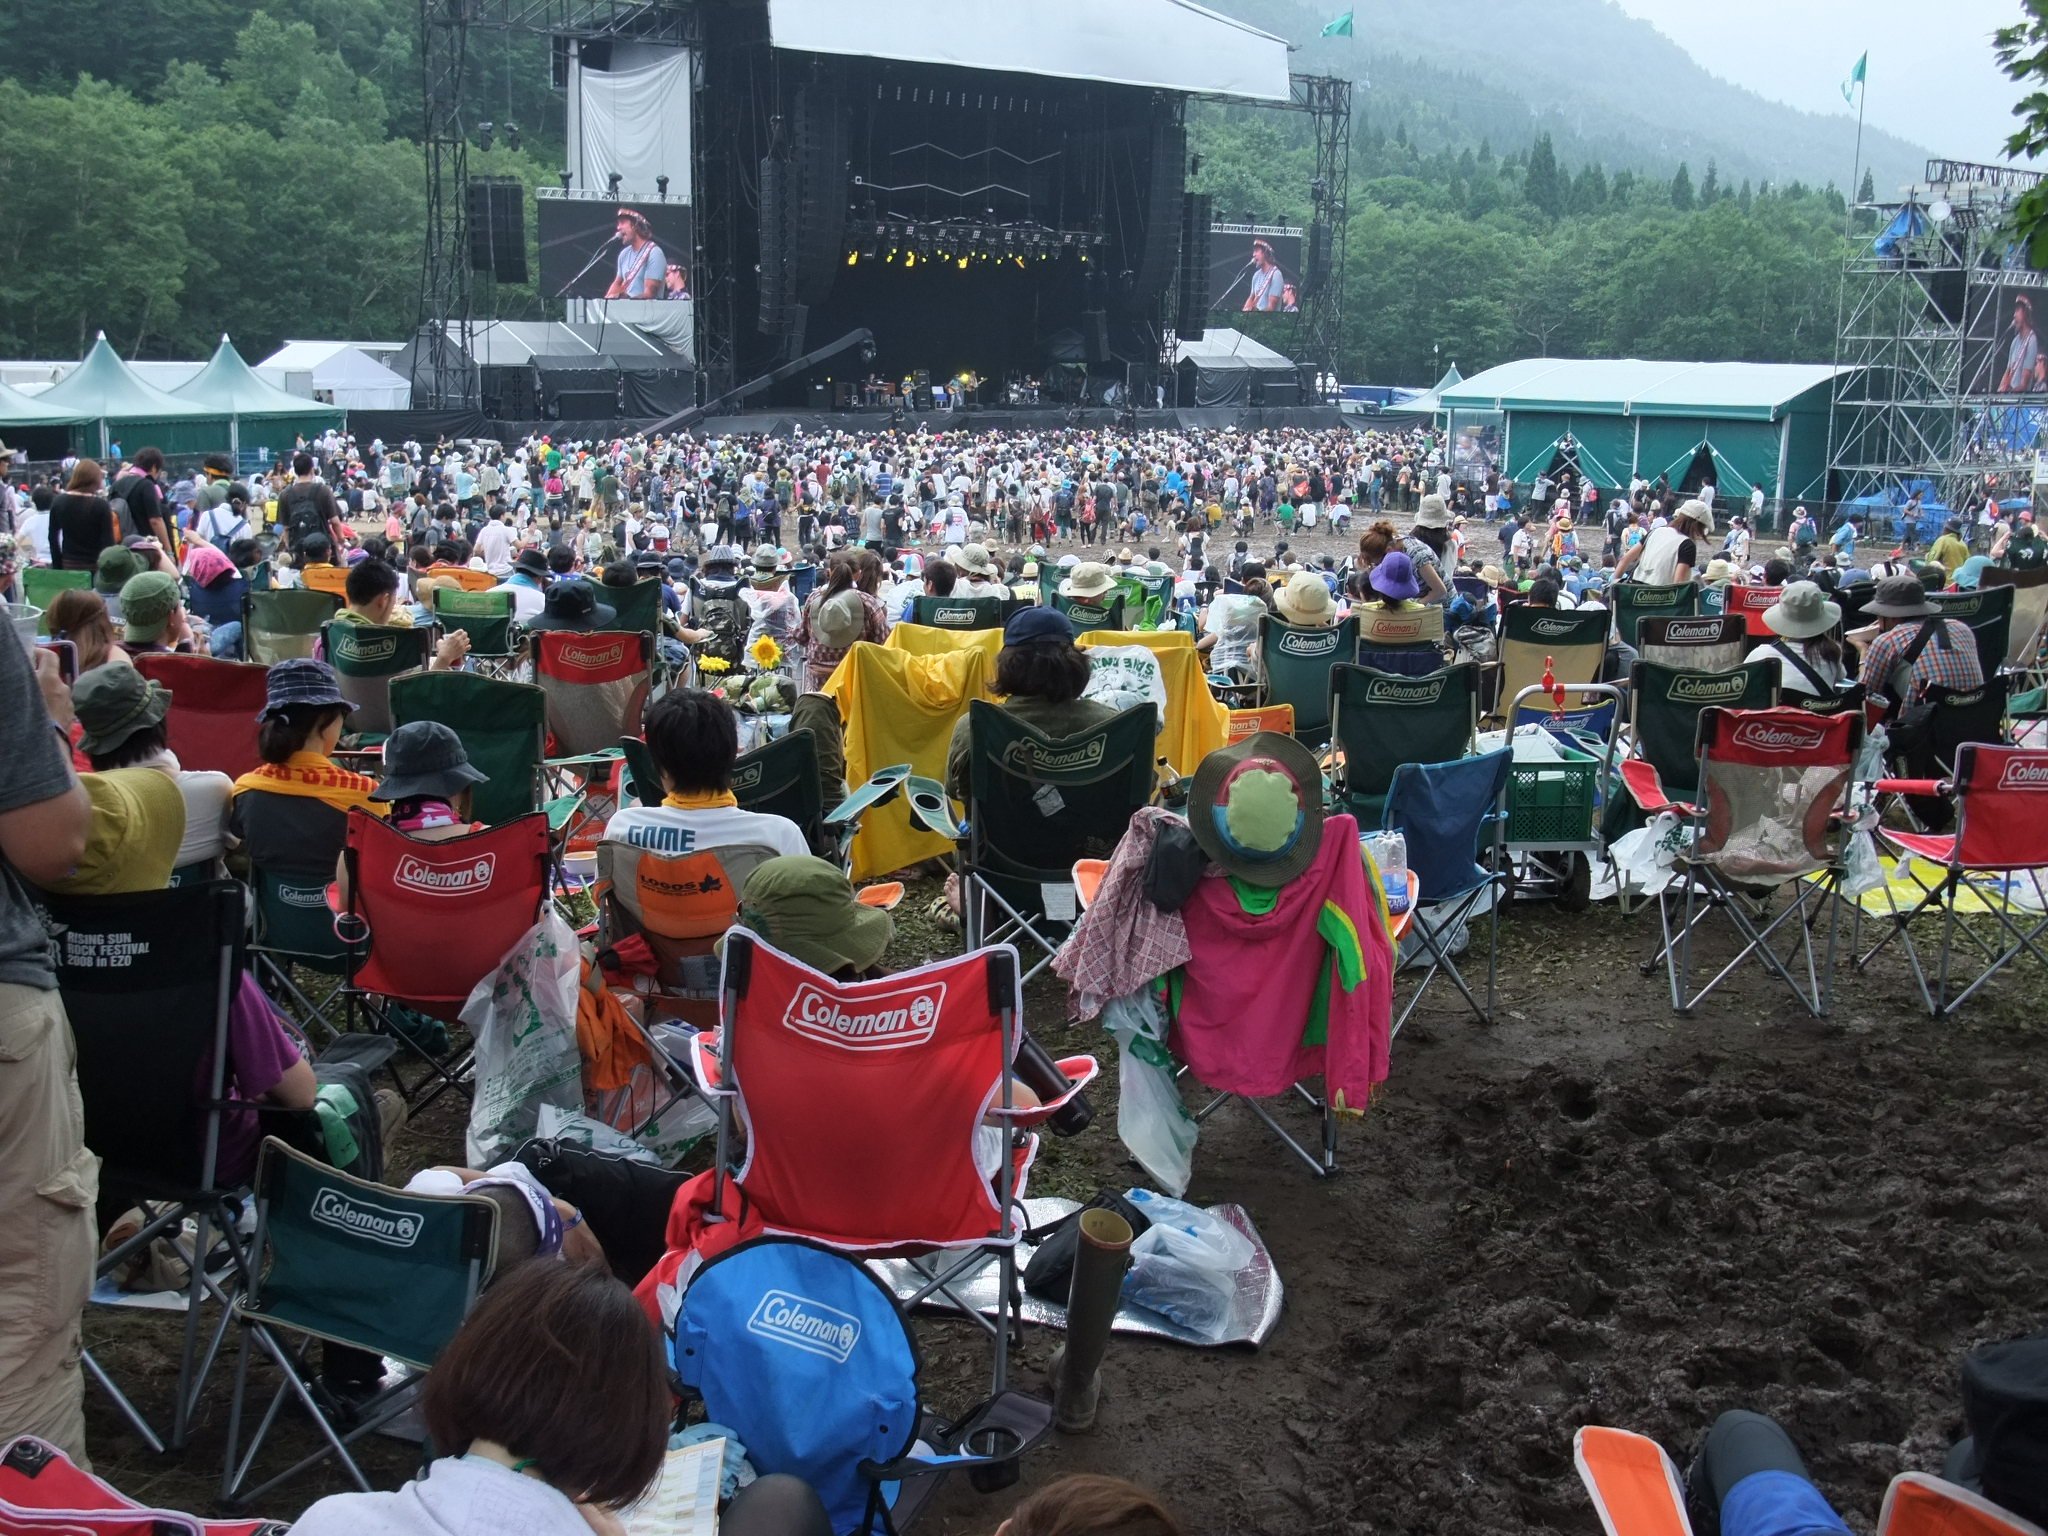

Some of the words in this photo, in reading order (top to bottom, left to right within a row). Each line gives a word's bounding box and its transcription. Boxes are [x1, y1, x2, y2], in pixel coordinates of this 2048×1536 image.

[1636, 591, 1669, 602] Coleman
[1748, 593, 1778, 604] Coleman
[938, 610, 967, 620] Coleman
[1072, 606, 1102, 620] Coleman
[1376, 622, 1411, 633] Coleman
[1669, 624, 1710, 637] Coleman
[342, 638, 382, 655] Coleman
[1286, 635, 1327, 649] Coleman
[565, 646, 610, 664] Coleman
[1373, 681, 1429, 698] Coleman
[1677, 678, 1731, 695] Coleman
[403, 860, 473, 887] Coleman
[67, 931, 105, 945] RISING
[107, 932, 132, 945] SUN
[67, 943, 97, 956] ROCK
[101, 942, 150, 956] FESTIVAL
[67, 954, 94, 967] 2008
[96, 956, 108, 967] in
[110, 955, 133, 967] EZO
[802, 992, 909, 1035] Coleman
[321, 1194, 396, 1235] Coleman
[763, 1297, 840, 1344] Coleman
